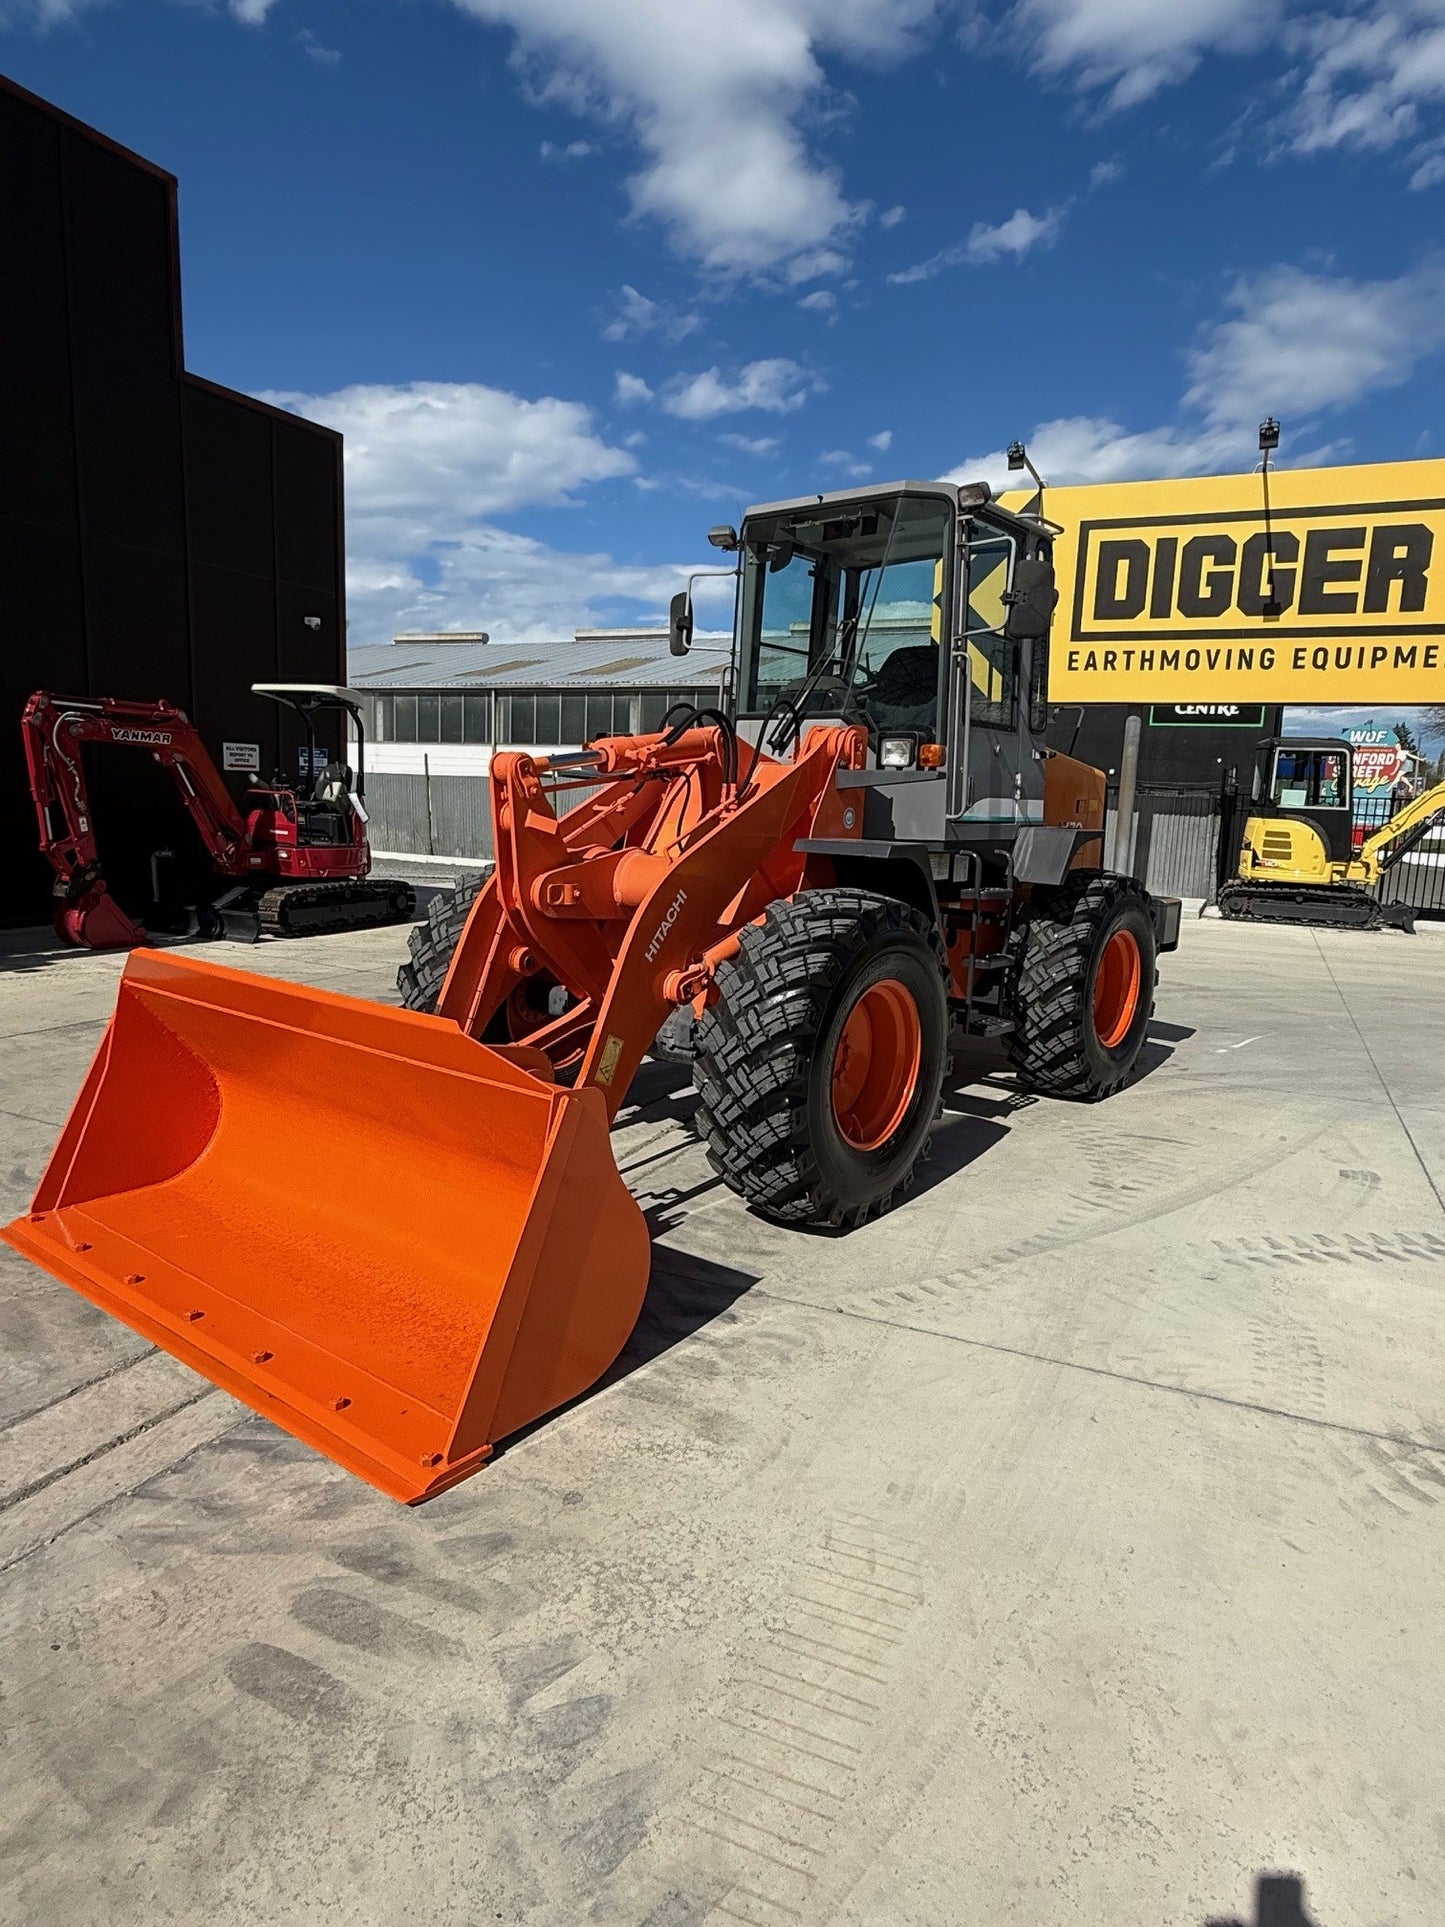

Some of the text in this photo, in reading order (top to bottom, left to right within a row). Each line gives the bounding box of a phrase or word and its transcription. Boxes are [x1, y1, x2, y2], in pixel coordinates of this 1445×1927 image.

[1093, 523, 1434, 620] DIGGER
[1067, 645, 1445, 671] EARTHMOVING EQUIPME
[111, 727, 172, 745] YANMAR
[644, 888, 688, 963] HITACHI
